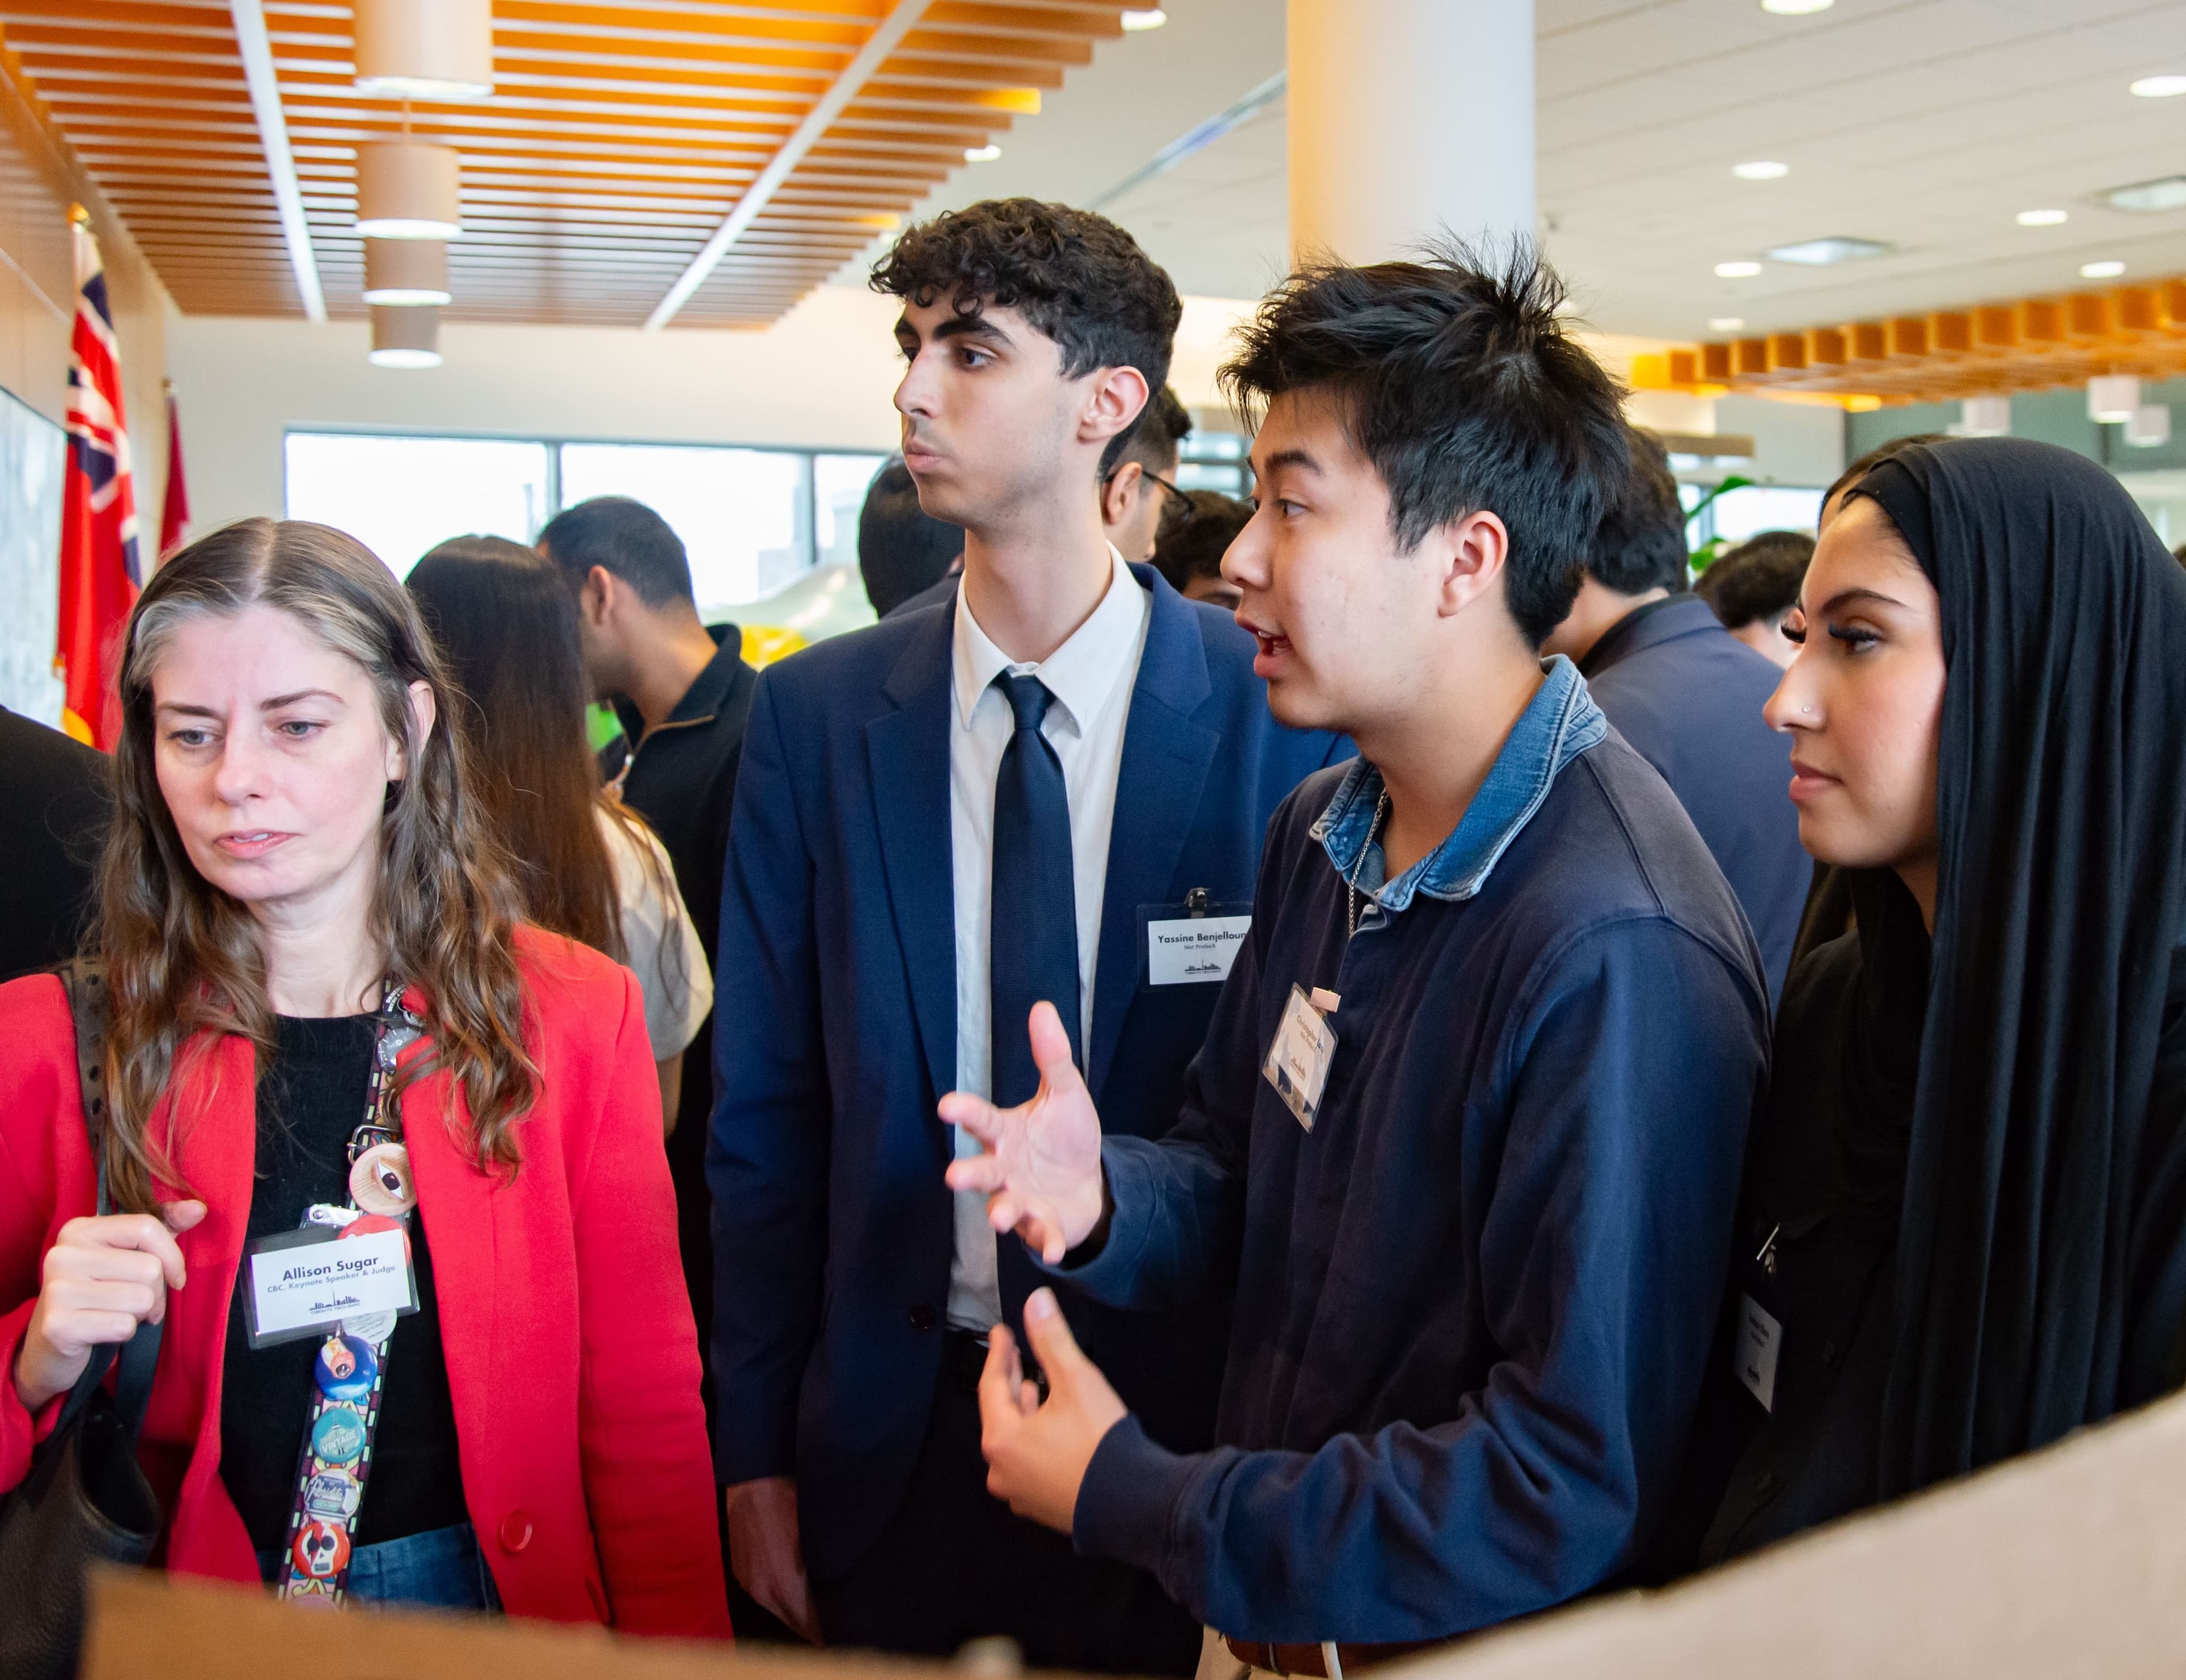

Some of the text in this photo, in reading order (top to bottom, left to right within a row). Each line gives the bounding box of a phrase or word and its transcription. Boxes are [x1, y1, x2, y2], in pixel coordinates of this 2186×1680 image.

[1158, 934, 1194, 943] Yassine
[268, 1284, 286, 1293] CBC,
[289, 1279, 323, 1289] Keynote
[326, 1272, 360, 1284] Speaker
[371, 1266, 396, 1275] Judge
[283, 1257, 379, 1281] Allison Sugar
[322, 1430, 357, 1453] VINTAGE
